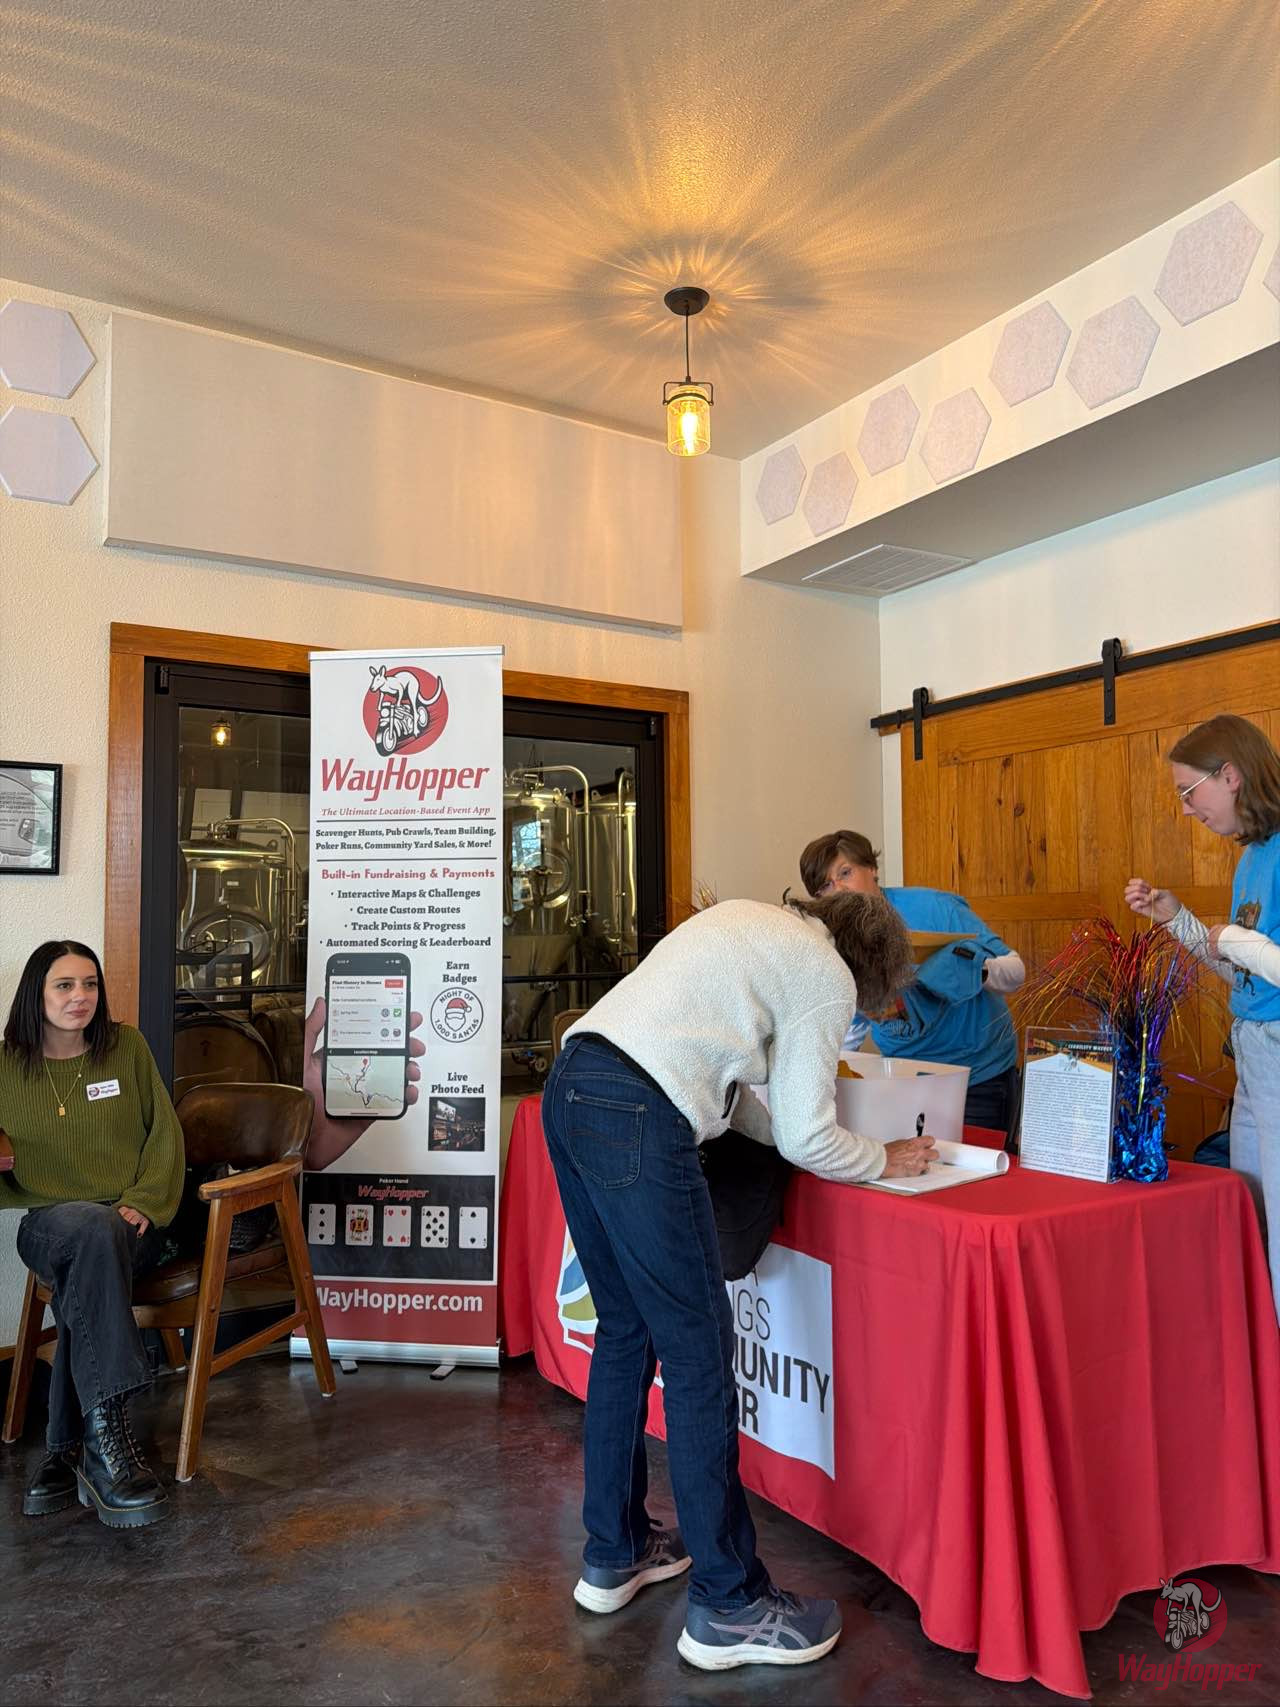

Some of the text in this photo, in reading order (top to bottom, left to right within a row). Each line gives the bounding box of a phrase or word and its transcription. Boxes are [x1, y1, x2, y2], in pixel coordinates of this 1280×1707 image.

[321, 757, 489, 801] WayHopper
[321, 808, 337, 816] The
[379, 807, 444, 815] Location-Based
[447, 806, 471, 814] Event
[473, 806, 490, 815] App
[315, 827, 496, 838] Scavenger Hunts, Pub Crawls, Team Building,
[315, 842, 339, 850] Poker
[341, 842, 363, 850] Runs,
[364, 841, 413, 851] Community
[434, 840, 457, 849] Sales,
[458, 840, 466, 848] &
[467, 840, 491, 848] More!
[322, 868, 495, 880] Built-in Fundraising & Payments
[338, 890, 390, 898] Interactive
[391, 890, 417, 900] Maps
[428, 889, 480, 900] Challenges
[357, 906, 460, 914] Create Custom Routes
[351, 922, 465, 932] Track Points & Progress
[326, 937, 491, 948] Automated Scoring & Leaderboard
[446, 962, 470, 970] Earn
[442, 973, 477, 985] Badges
[439, 990, 475, 1003] NIGHT OF
[452, 1019, 479, 1039] SANTAS
[447, 1072, 468, 1082] Live
[431, 1085, 485, 1095] Photo Feed
